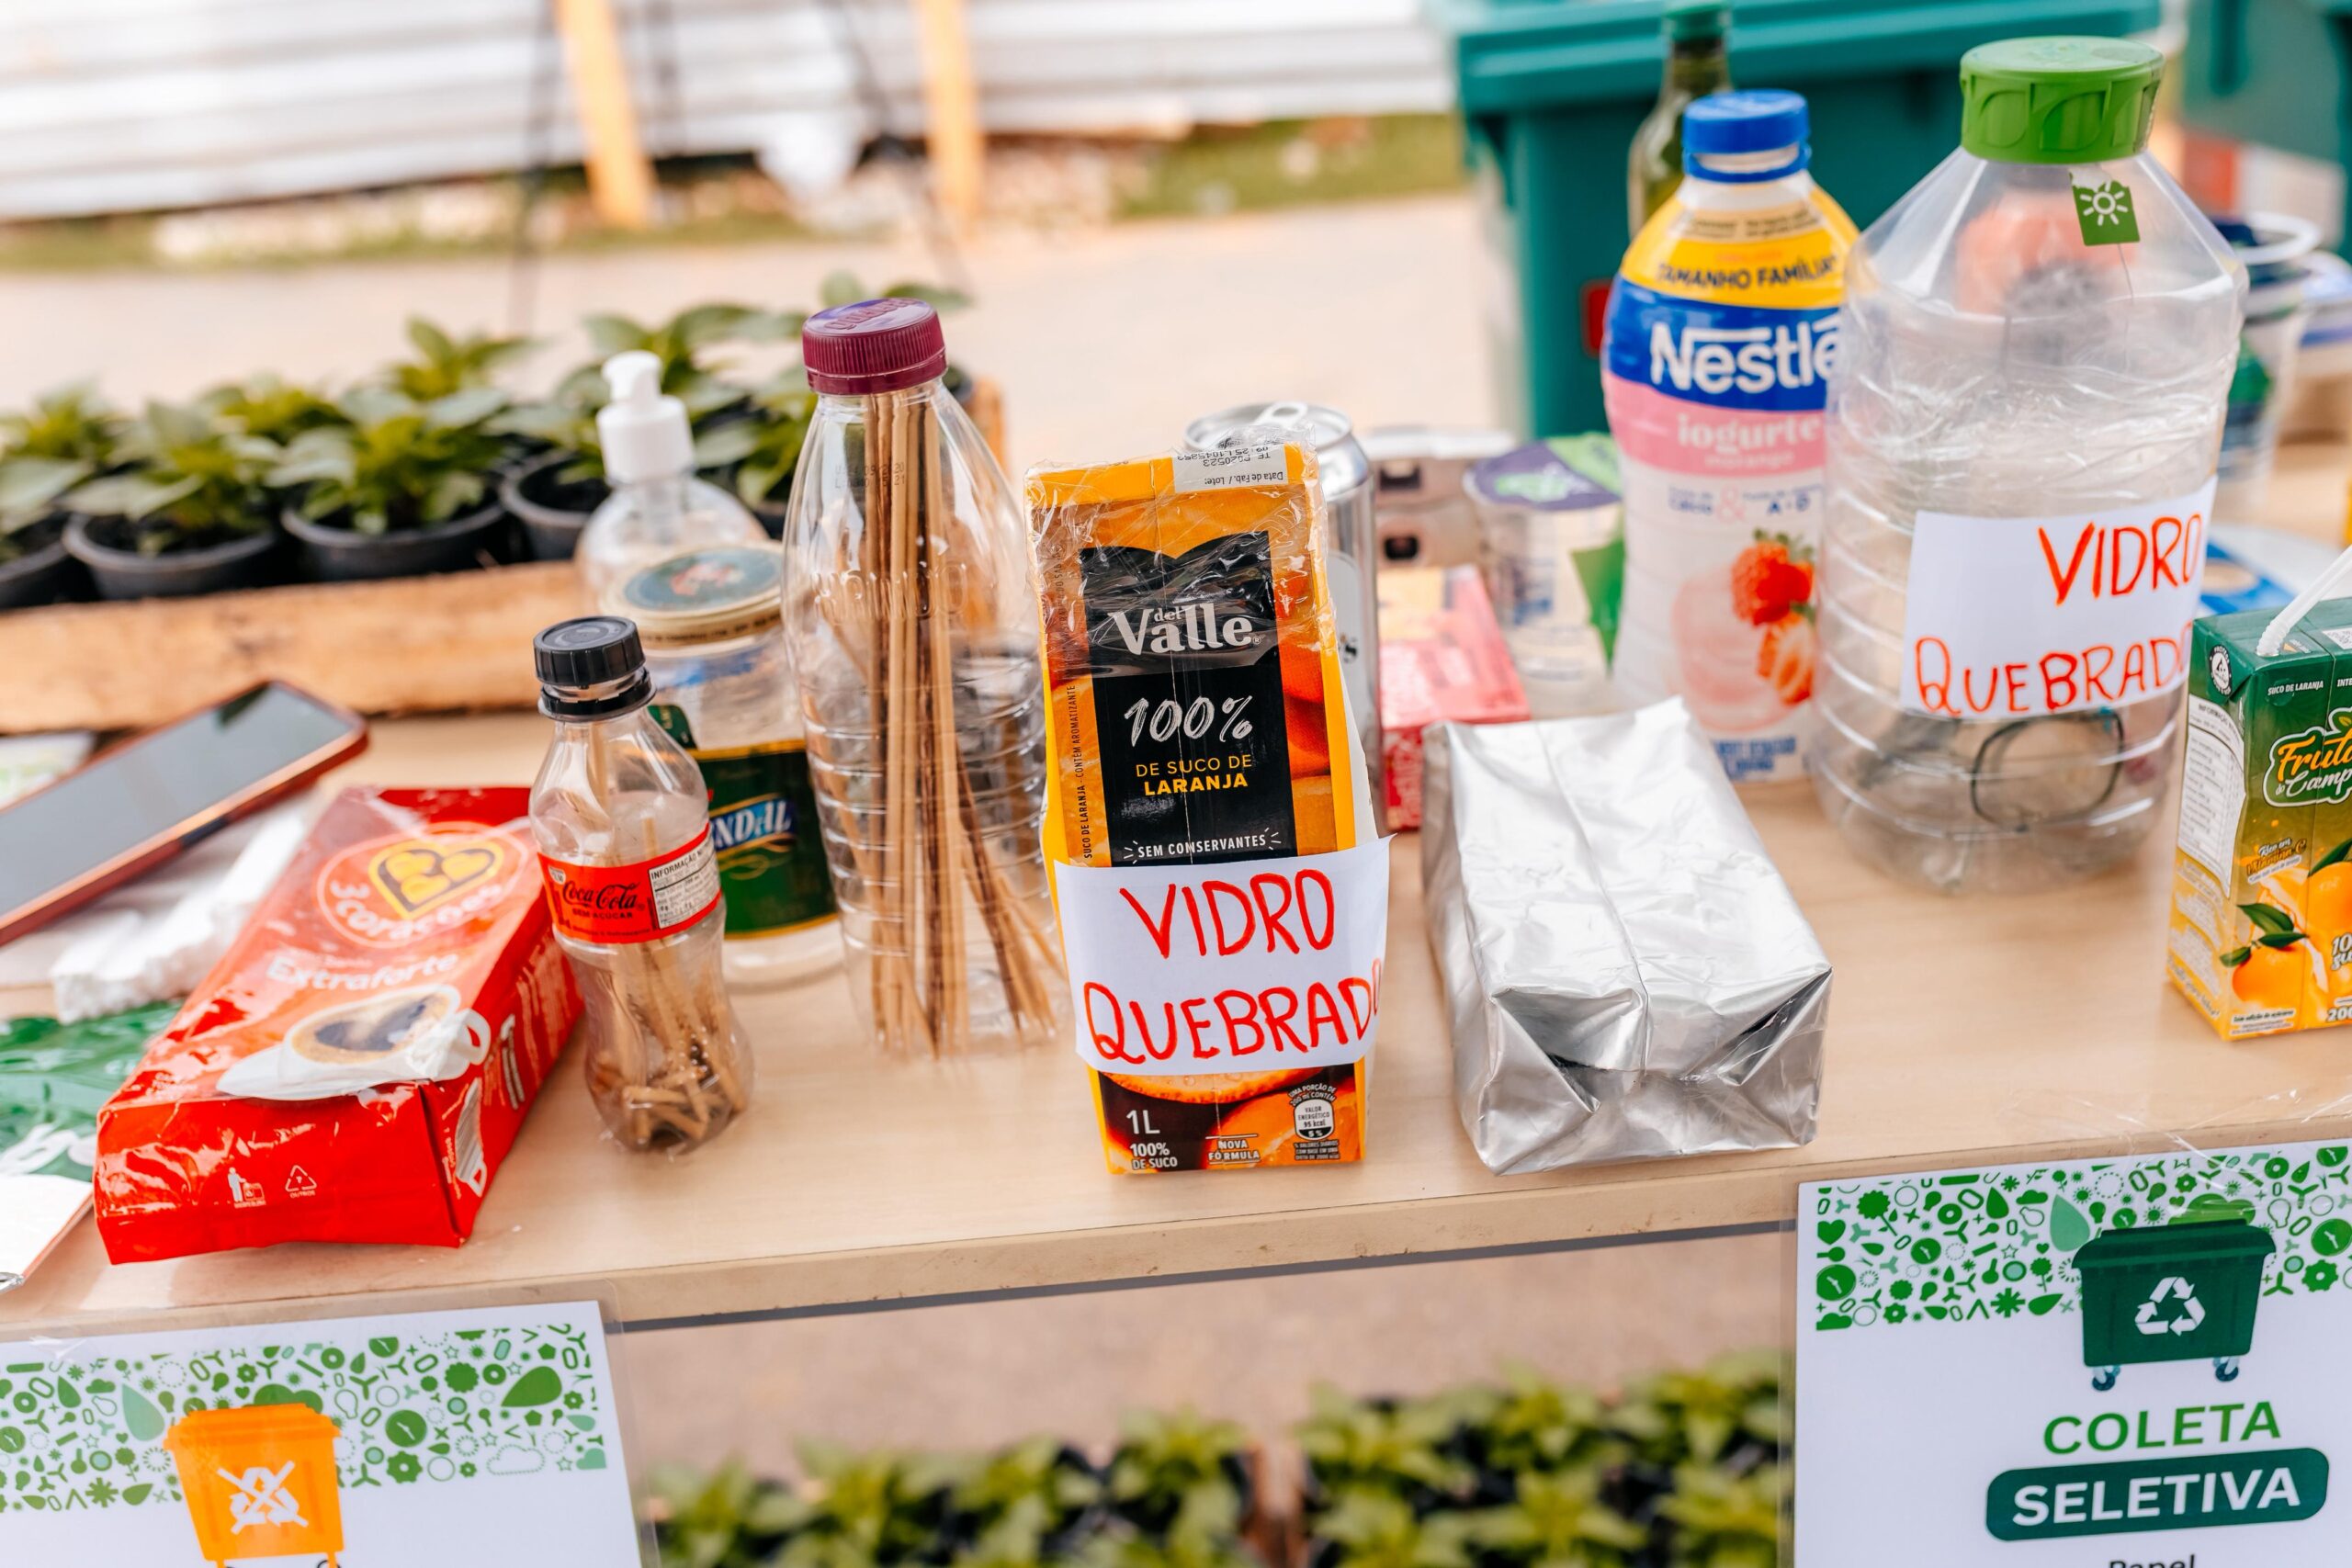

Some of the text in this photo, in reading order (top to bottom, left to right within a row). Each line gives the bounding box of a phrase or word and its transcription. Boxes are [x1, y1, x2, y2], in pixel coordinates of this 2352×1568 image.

[1678, 412, 1821, 453] iogurte
[1204, 476, 1226, 485] Lote:
[1234, 473, 1250, 483] Fab.
[1251, 472, 1263, 481] de
[1263, 471, 1283, 480] Data
[2038, 513, 2201, 607] VIDRO
[1154, 606, 1182, 623] del
[1106, 602, 1253, 656] Valle
[2267, 685, 2285, 697] SUCO
[2285, 683, 2295, 694] DE
[2295, 680, 2325, 693] LARANJA
[1066, 685, 1081, 744] AROMATIZANTE
[1124, 694, 1253, 748] 100%
[1136, 753, 1252, 777] DE SUCO DE
[1144, 772, 1249, 797] LARANJA
[1078, 784, 1090, 823] LARANJA
[1080, 824, 1091, 836] DE
[1083, 838, 1092, 859] SUCO
[1137, 833, 1267, 859] SEM CONSERVANTES
[1119, 869, 1335, 959] VIDRO
[266, 953, 458, 991] Extraforte
[1129, 1141, 1170, 1157] 100%
[1208, 1149, 1261, 1162] FÓRMULA
[1218, 1139, 1248, 1150] NOVA
[1132, 1156, 1179, 1171] DE SUCO
[2043, 1401, 2282, 1456] COLETA
[2012, 1467, 2301, 1528] SELETIVA
